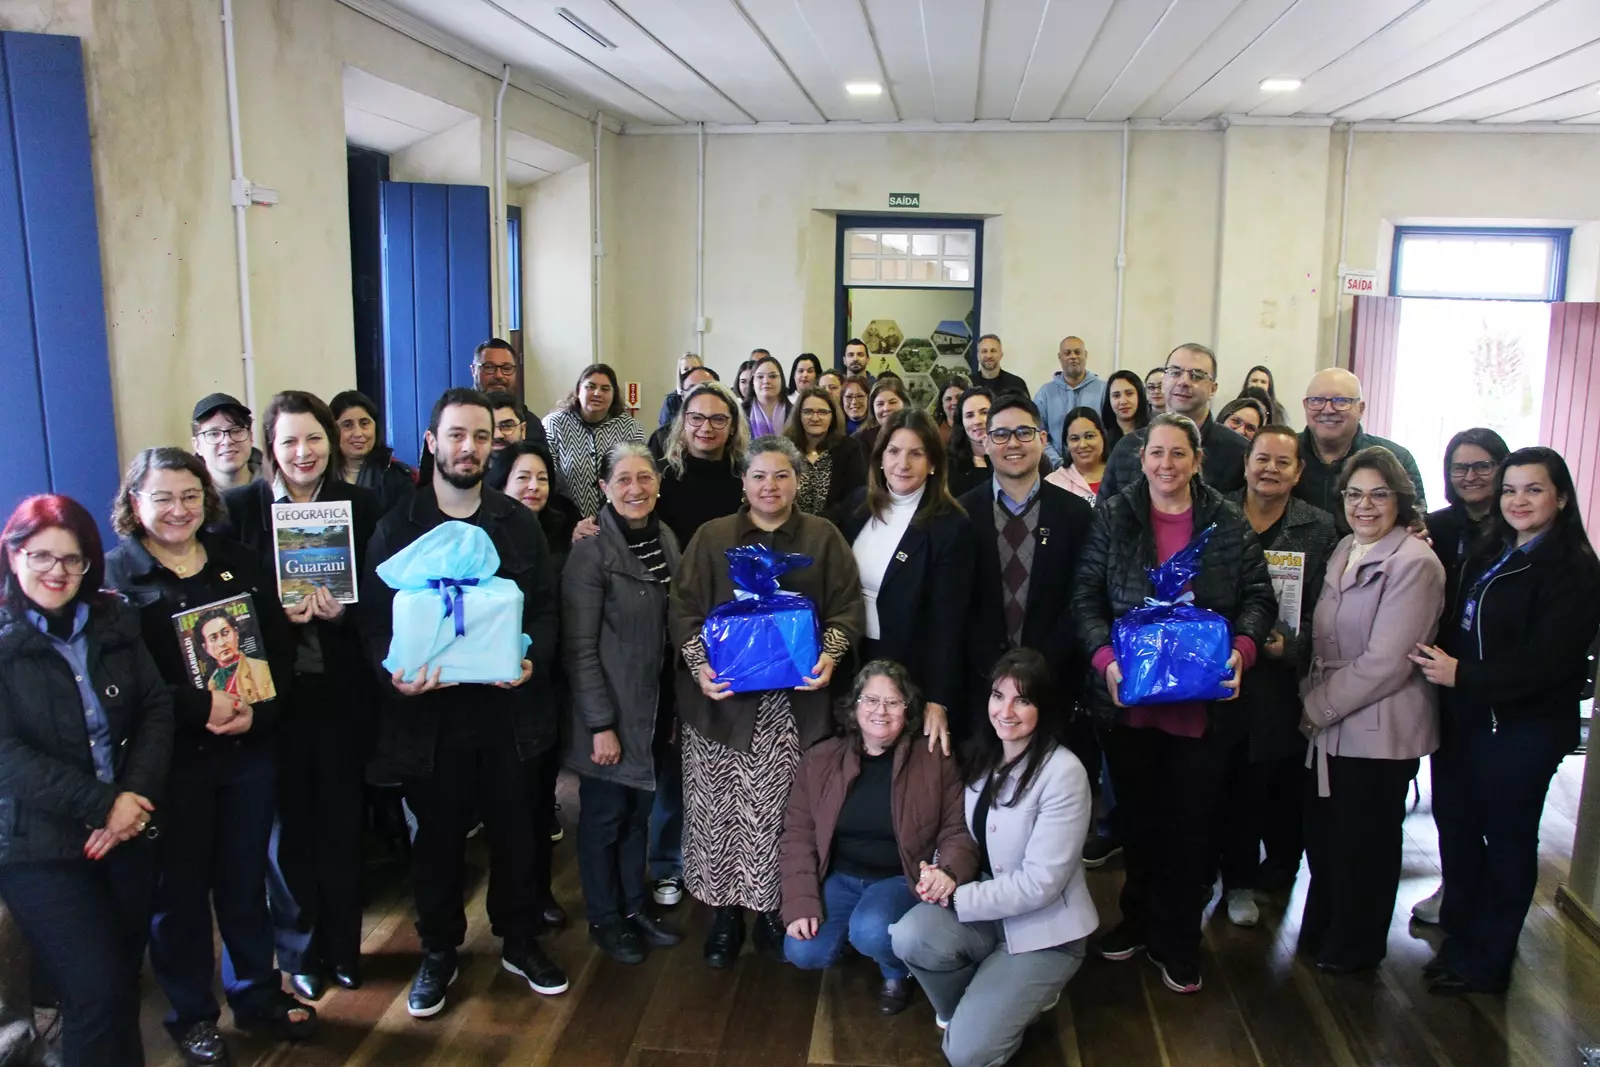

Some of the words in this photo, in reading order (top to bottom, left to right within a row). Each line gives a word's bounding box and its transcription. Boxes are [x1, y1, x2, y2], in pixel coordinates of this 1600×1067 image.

[890, 196, 919, 206] SAÍDA
[1347, 278, 1373, 291] SAÍDA
[285, 557, 345, 574] Guarani
